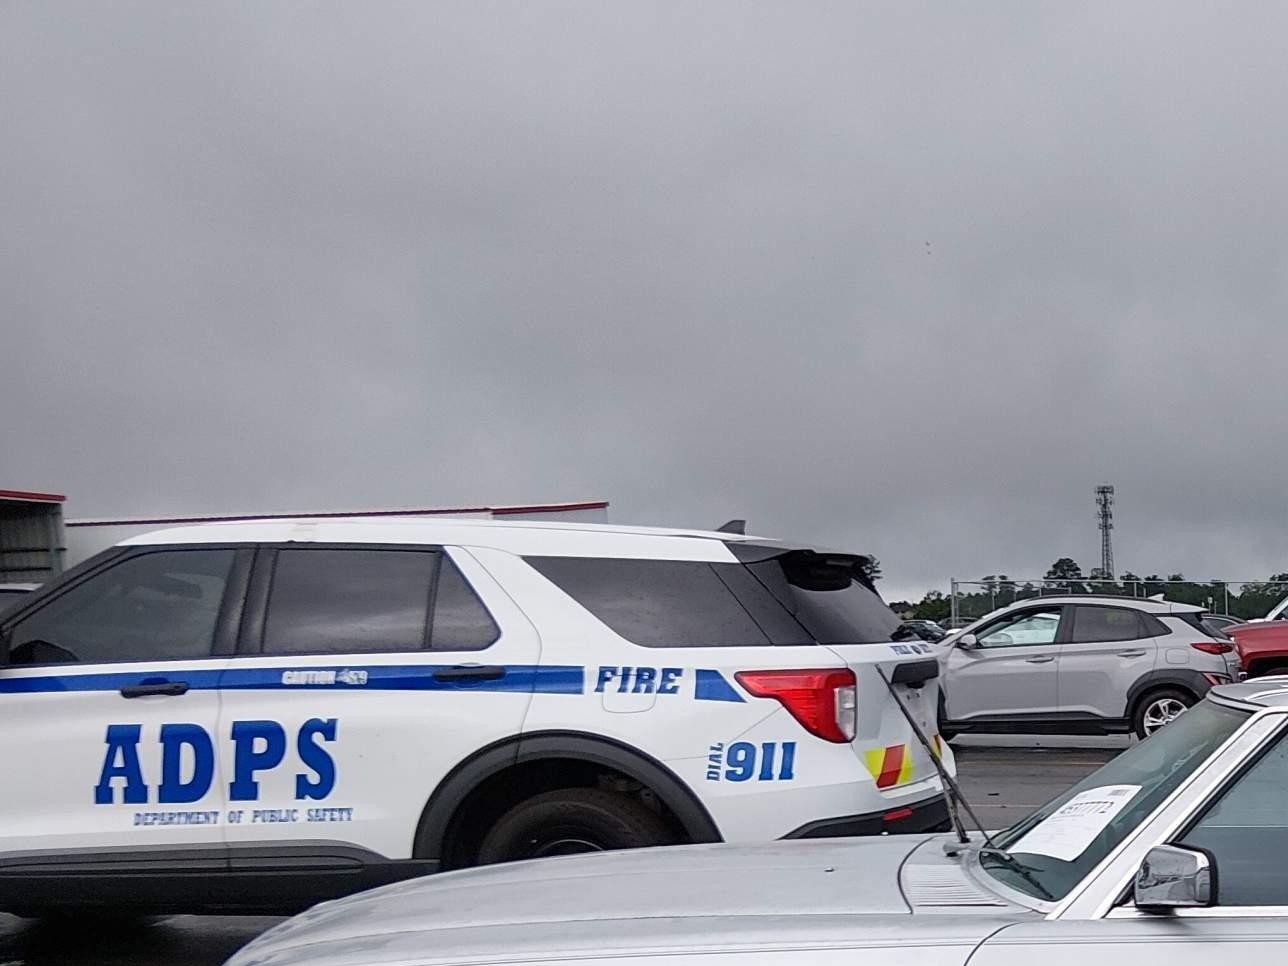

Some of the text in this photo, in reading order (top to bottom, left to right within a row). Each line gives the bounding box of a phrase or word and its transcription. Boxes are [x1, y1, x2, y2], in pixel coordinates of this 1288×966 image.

[595, 666, 684, 694] FIRE
[94, 718, 338, 804] ADPS
[707, 742, 723, 781] DIAL
[725, 741, 797, 782] 911
[134, 807, 354, 826] DEPARTMENT OF PUBLIC SAFETY
